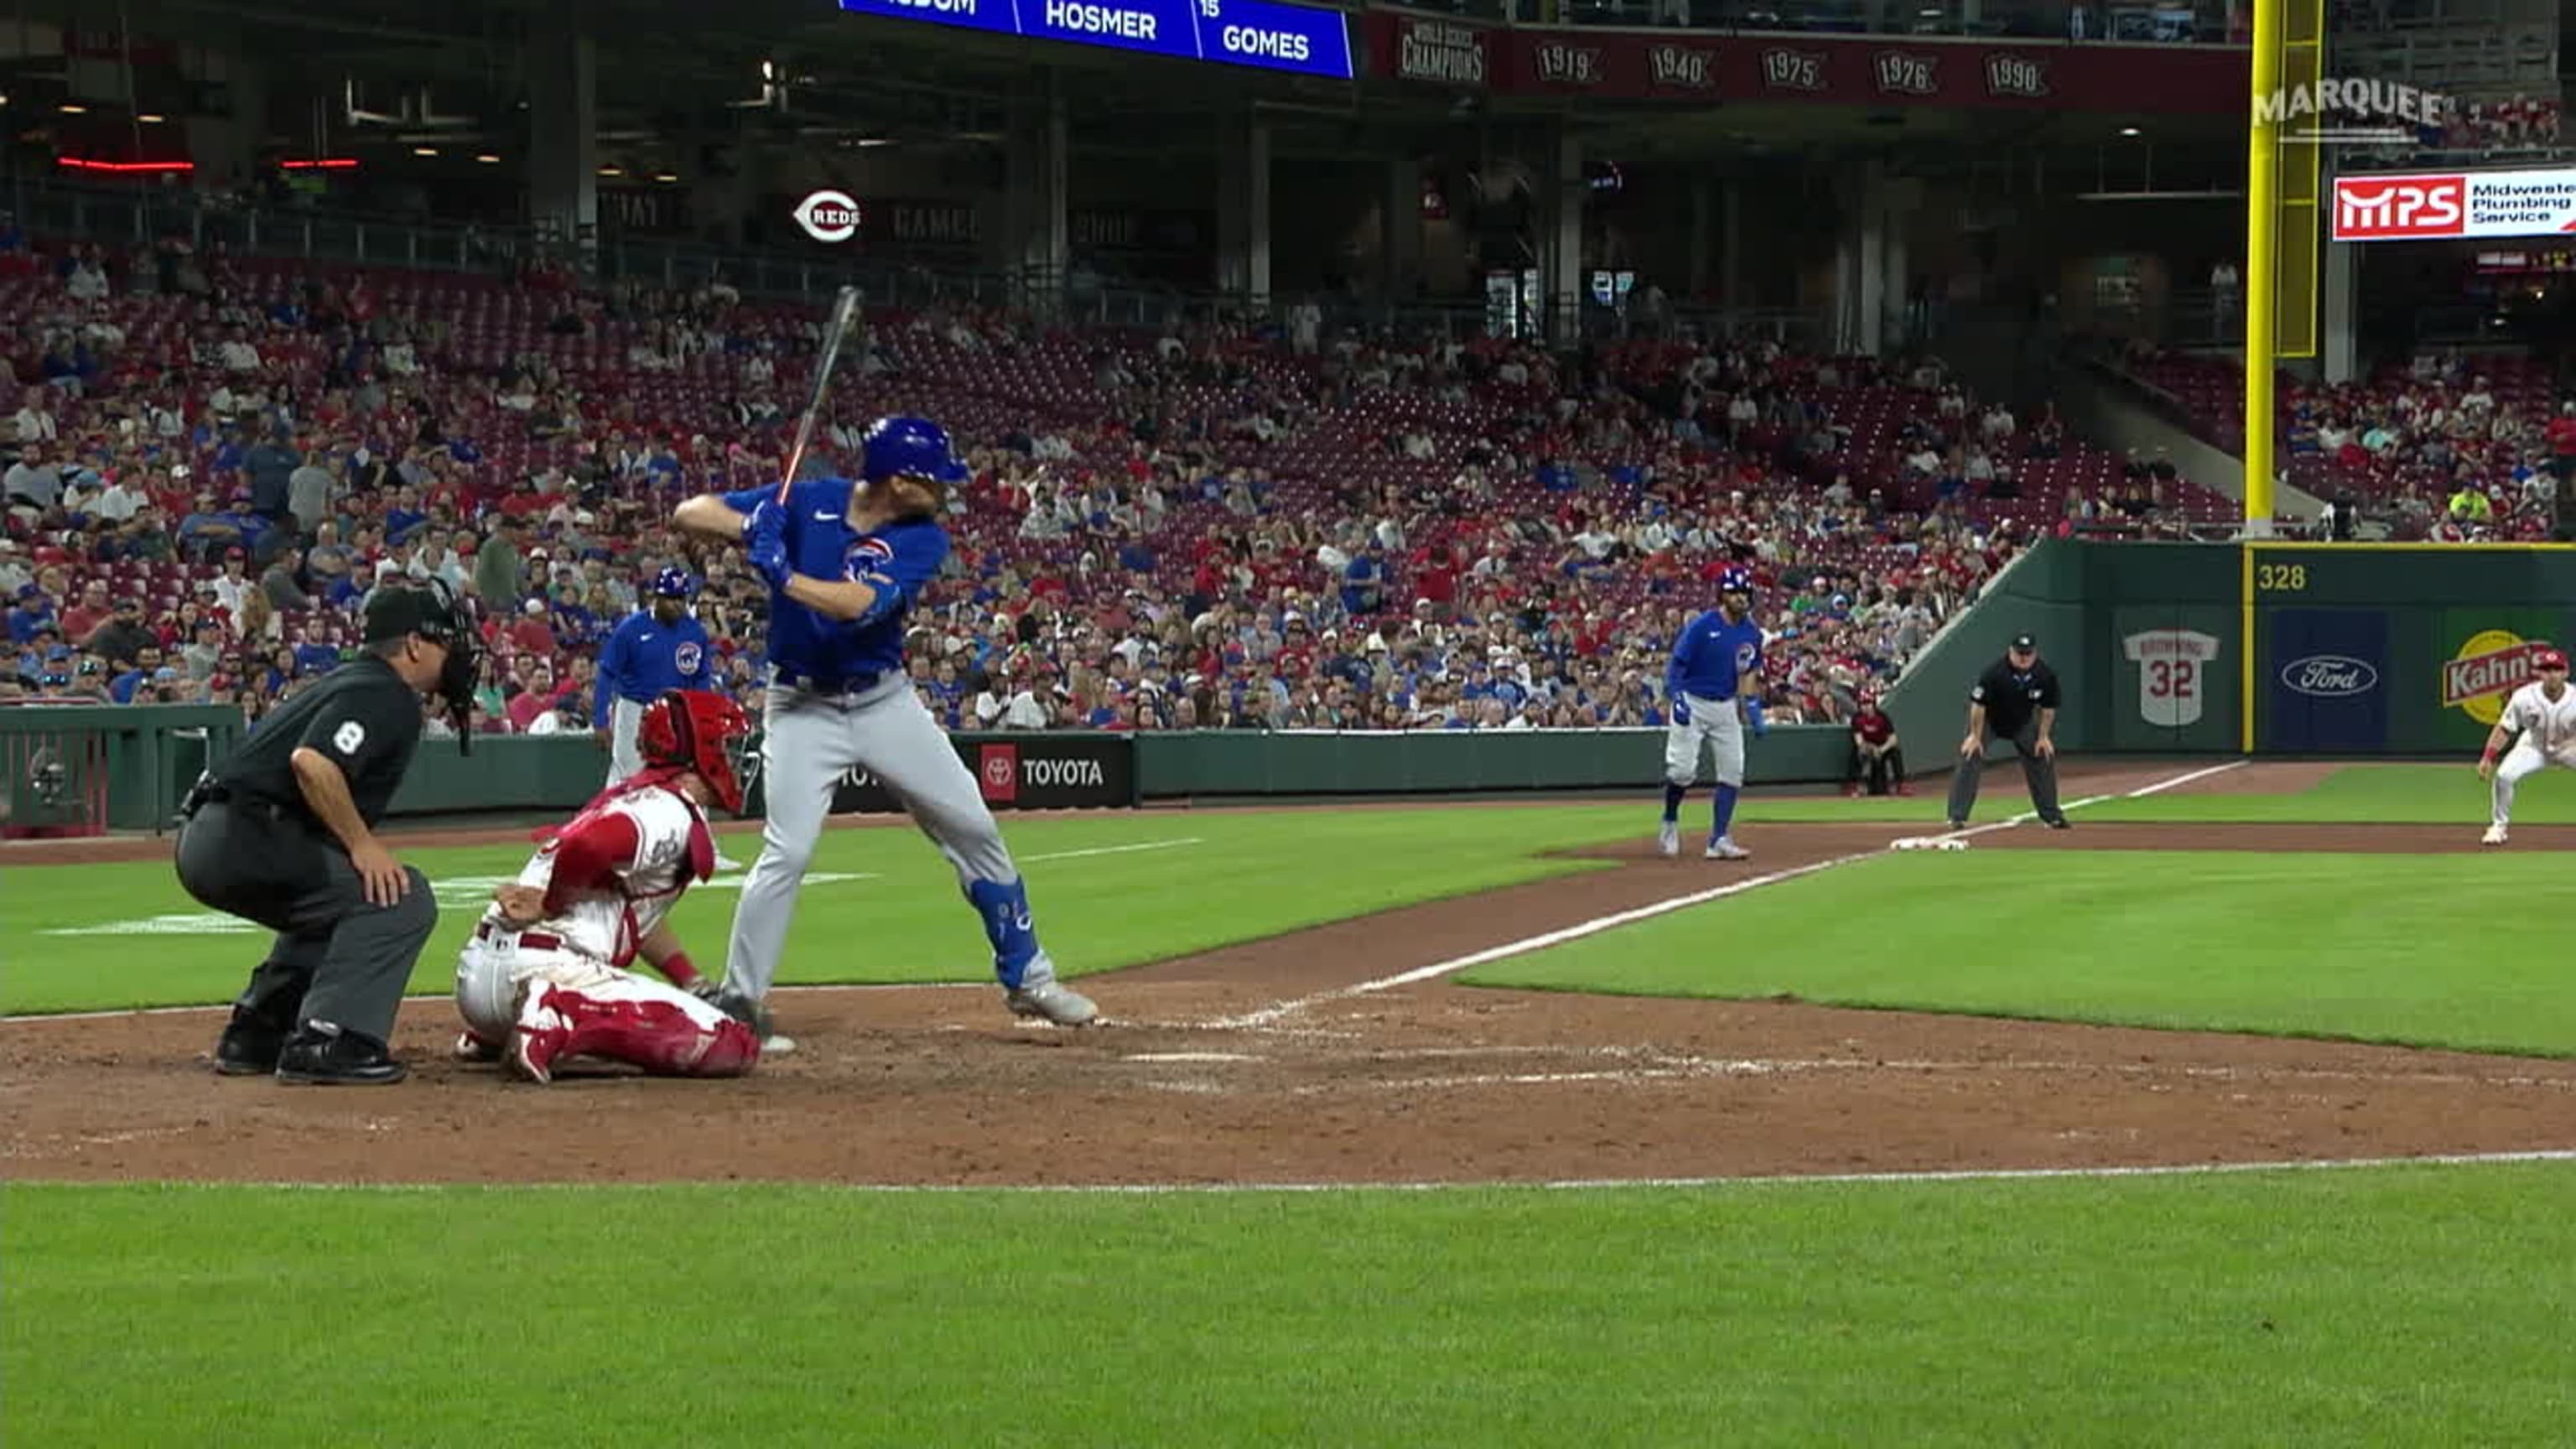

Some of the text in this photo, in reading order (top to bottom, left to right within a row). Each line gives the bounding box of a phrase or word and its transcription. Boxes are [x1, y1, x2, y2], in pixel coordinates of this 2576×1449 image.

[1046, 0, 1156, 40] HOSMER
[1200, 0, 1220, 17] 15
[1223, 25, 1309, 60] GOMES
[1402, 34, 1483, 81] CHAMPIONS
[1542, 45, 1589, 80] 1919
[1654, 47, 1702, 82] 1940
[1768, 52, 1815, 85] 1975
[1881, 56, 1927, 89] 1976
[1992, 59, 2037, 91] 1990
[813, 209, 860, 225] REDS
[2340, 185, 2460, 229] MPS
[2473, 197, 2571, 210] Plumbing
[2473, 211, 2551, 224] Service
[2259, 564, 2305, 589] 328
[2150, 660, 2193, 698] 32
[2301, 661, 2359, 688] Ford
[334, 720, 365, 755] 8
[1022, 759, 1104, 786] TOYOTA
